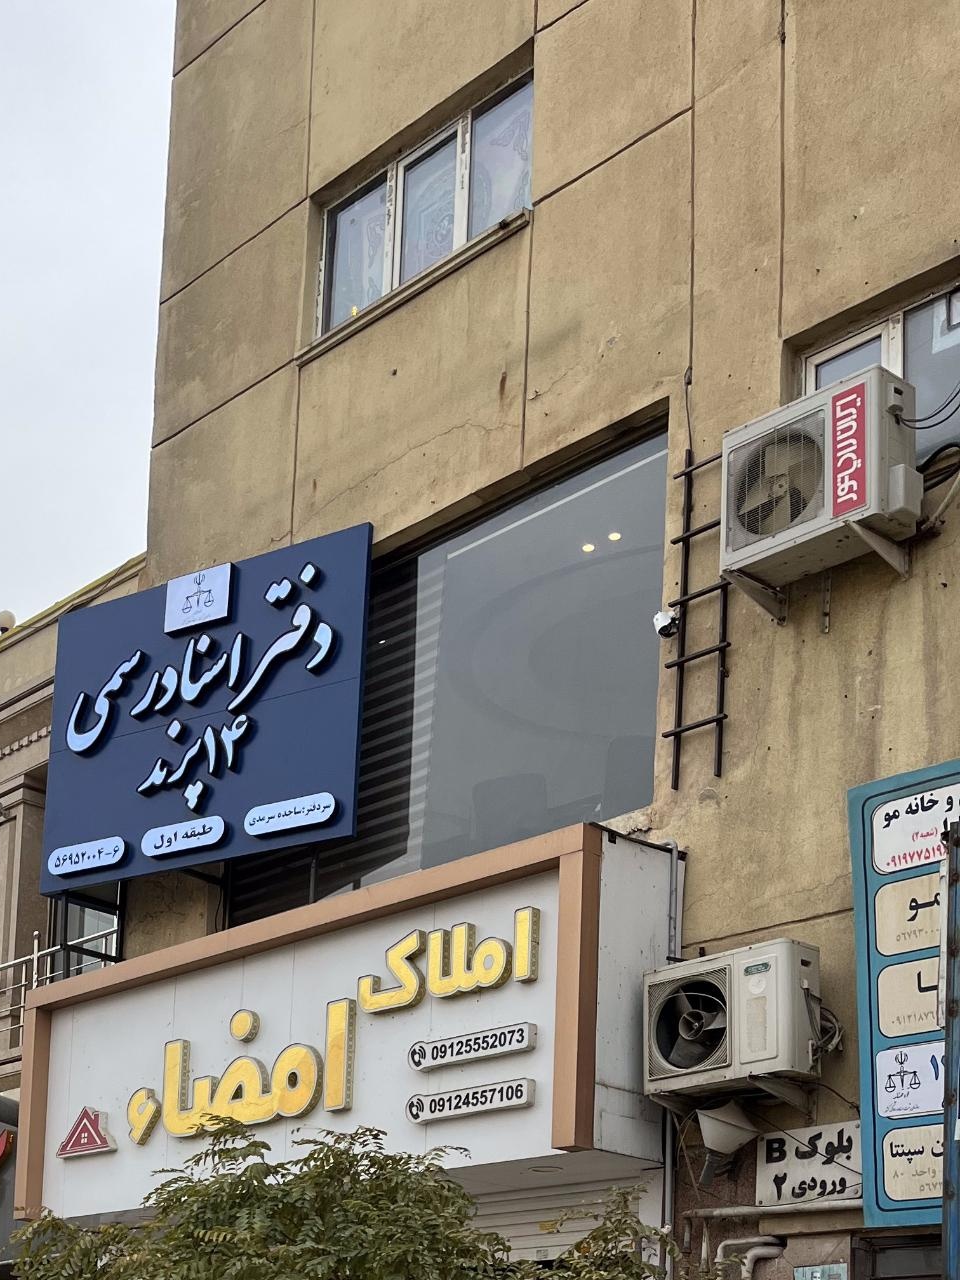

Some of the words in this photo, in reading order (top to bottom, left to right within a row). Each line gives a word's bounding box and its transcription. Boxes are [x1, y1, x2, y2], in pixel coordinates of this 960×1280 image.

[227, 561, 333, 712] دفتر
[152, 632, 243, 712] اسناد
[65, 649, 160, 753] رسمی
[136, 719, 203, 811] پرند
[882, 808, 901, 829] مو
[905, 792, 940, 816] خانه
[153, 831, 179, 850] اول
[181, 823, 214, 840] طبقه
[357, 906, 541, 1014] املاک
[431, 1027, 526, 1061] 09125552073
[126, 997, 356, 1146] امضاء
[429, 1083, 524, 1114] 09124557106
[765, 1137, 788, 1164] B
[795, 1127, 853, 1166] بلوک
[889, 1140, 925, 1165] سپنتا
[772, 1172, 788, 1201] ۲
[791, 1176, 847, 1199] ورودی
